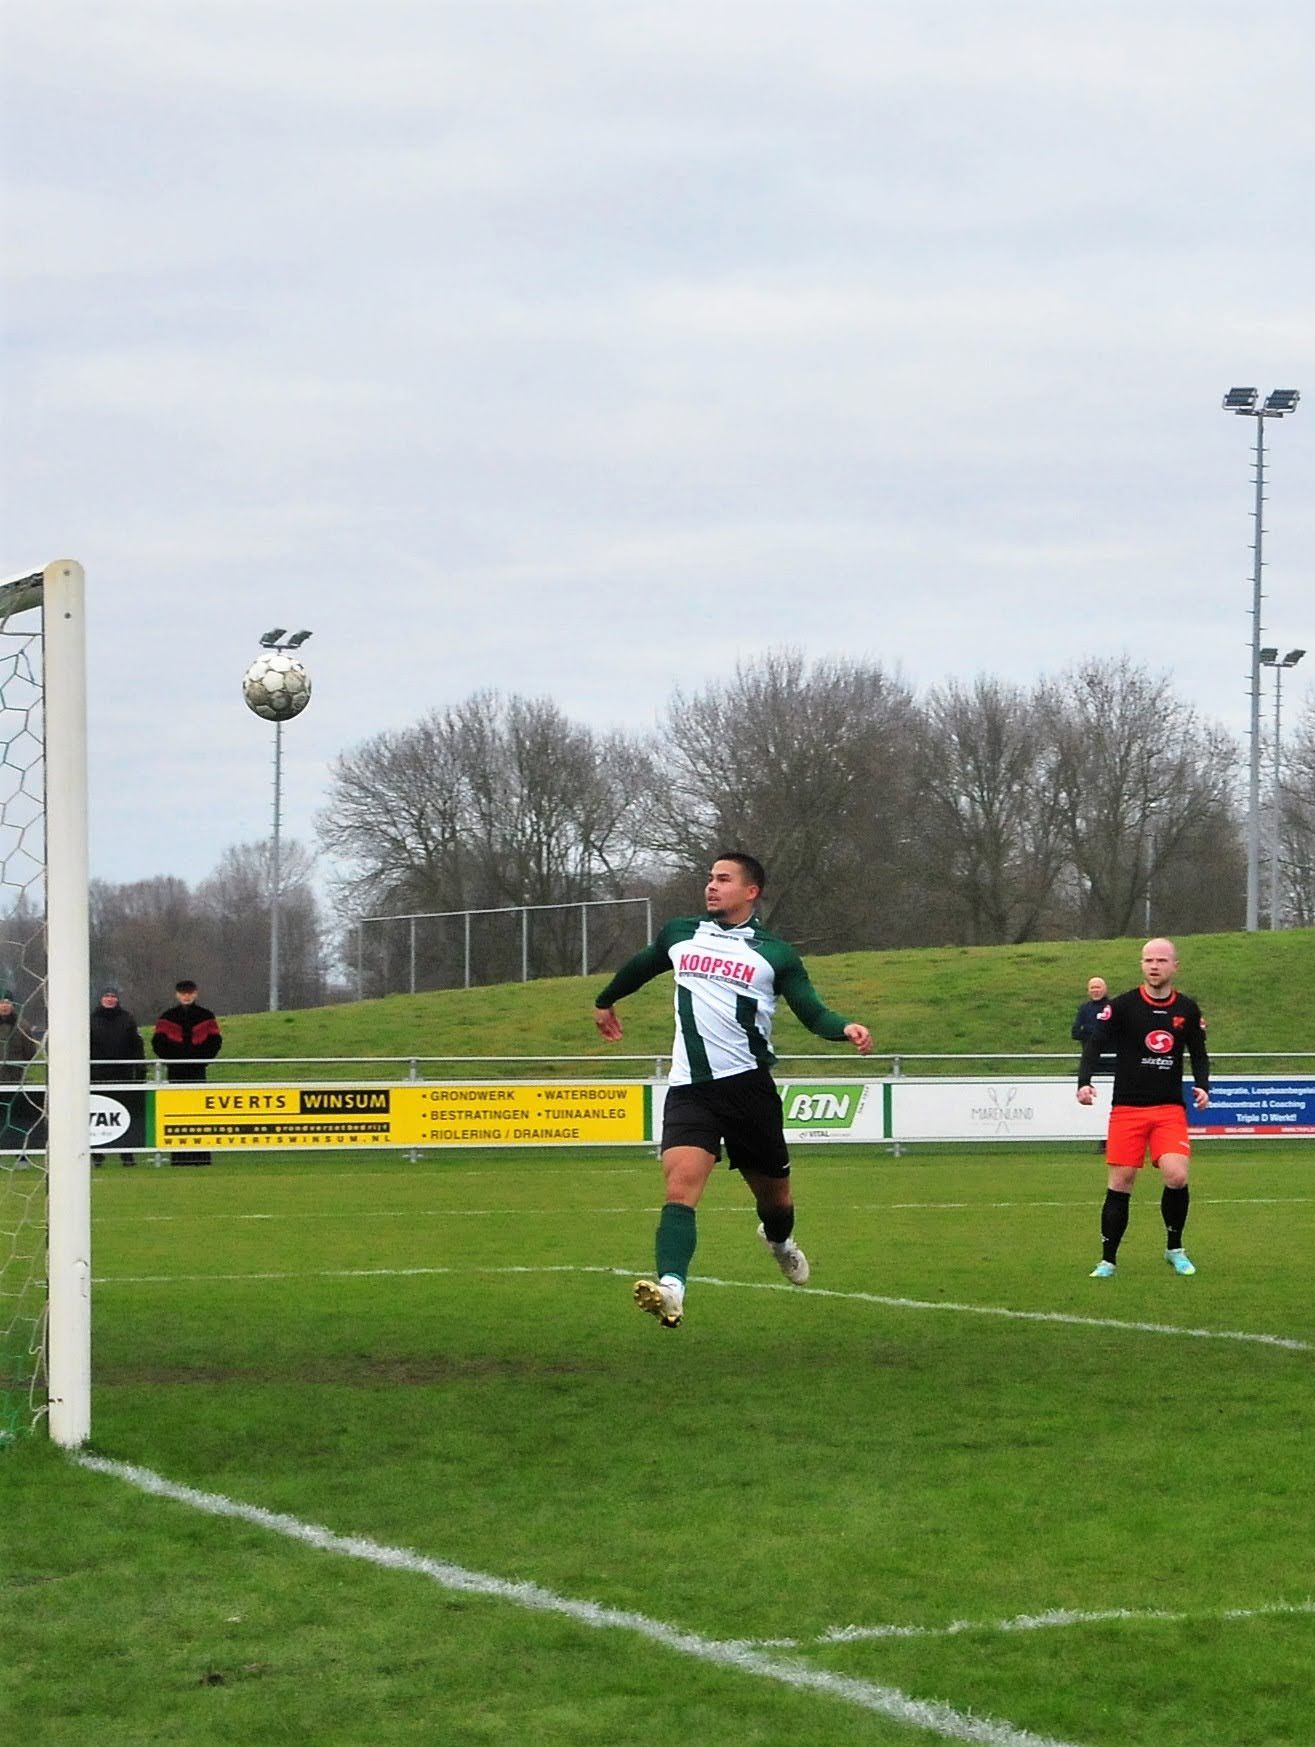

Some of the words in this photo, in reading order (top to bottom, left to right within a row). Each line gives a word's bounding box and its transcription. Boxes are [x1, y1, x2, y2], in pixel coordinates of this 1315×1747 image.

[679, 953, 756, 982] KOOPSEN
[304, 1093, 387, 1109] WINSUM
[430, 1090, 516, 1101] GRONDWERK
[544, 1089, 628, 1101] WATERBOUW
[204, 1095, 287, 1110] EVERTS
[1269, 1100, 1307, 1109] Coaching
[430, 1110, 530, 1121] BESTRATINGEN
[544, 1108, 627, 1120] TUINAANLEG
[1236, 1113, 1259, 1123] Triple
[1261, 1113, 1269, 1122] D
[430, 1128, 502, 1140] RIOLERING
[513, 1127, 580, 1139] DRAINAGE
[164, 1135, 391, 1145] WWW.EVERTSWINSUM.NL
